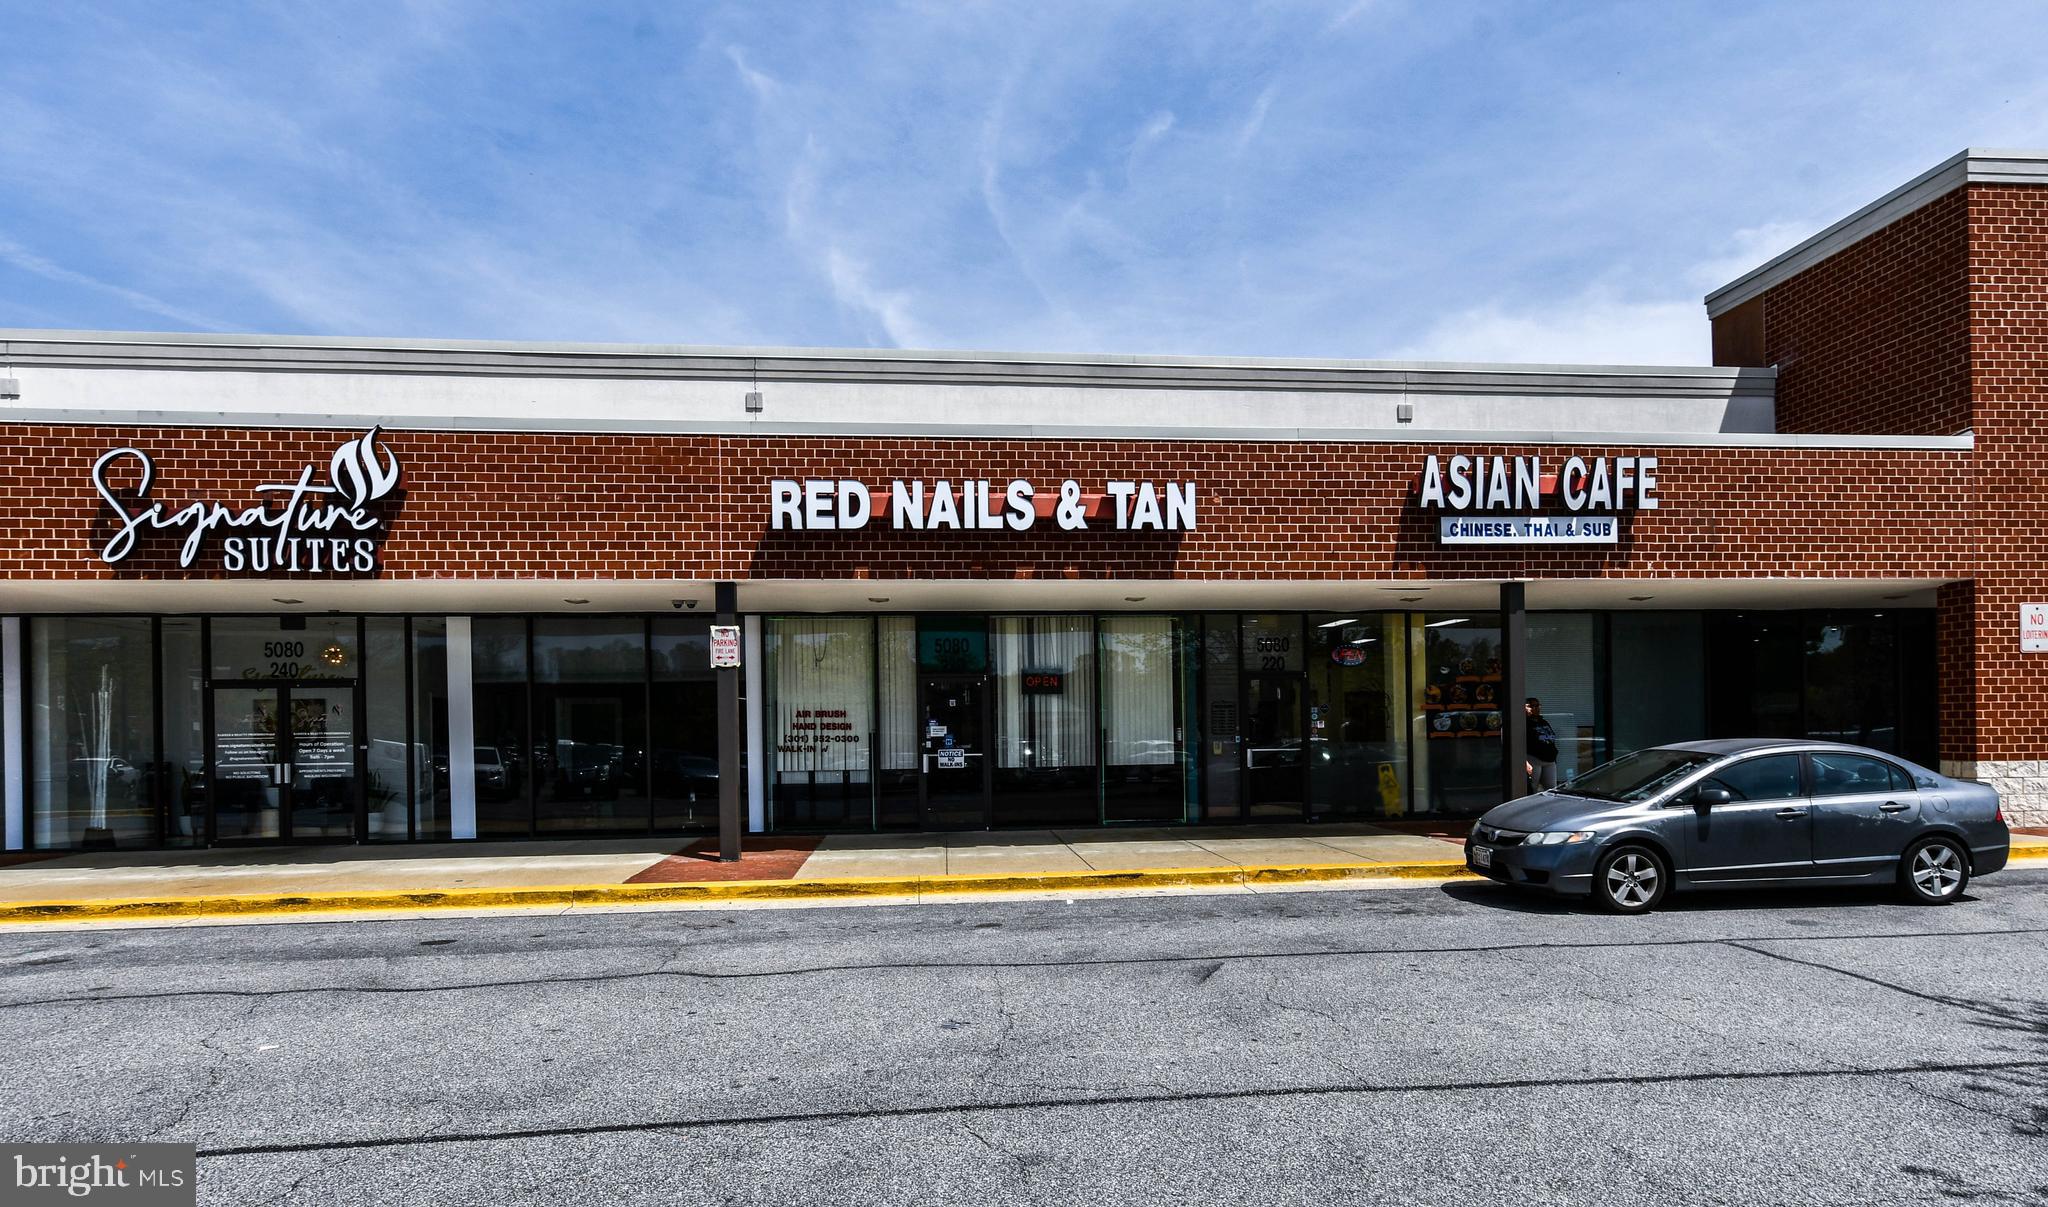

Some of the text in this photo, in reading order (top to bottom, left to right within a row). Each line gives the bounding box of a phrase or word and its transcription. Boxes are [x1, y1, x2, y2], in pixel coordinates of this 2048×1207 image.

[1420, 455, 1659, 511] ASIAN CAFE
[92, 447, 379, 568] Signature
[771, 479, 1196, 531] RED NAILS & TAN
[1524, 523, 1559, 537] THAI
[1566, 523, 1576, 537] &
[1583, 523, 1612, 537] SUB
[224, 537, 375, 572] SUITES
[2030, 613, 2044, 625] NO
[2023, 630, 2048, 640] LOITERIN
[263, 641, 305, 658] 5080
[713, 639, 738, 647] PARKING
[934, 638, 970, 654] 5080
[1256, 637, 1290, 653] 5080
[270, 662, 299, 678] 240
[1262, 656, 1286, 671] 220
[1026, 676, 1058, 688] OPEN
[796, 710, 847, 718] AIR BRUSH
[792, 723, 852, 731] HAND DESIGN
[783, 735, 860, 743] (301) 952-0300
[776, 745, 817, 753] WALK-IN
